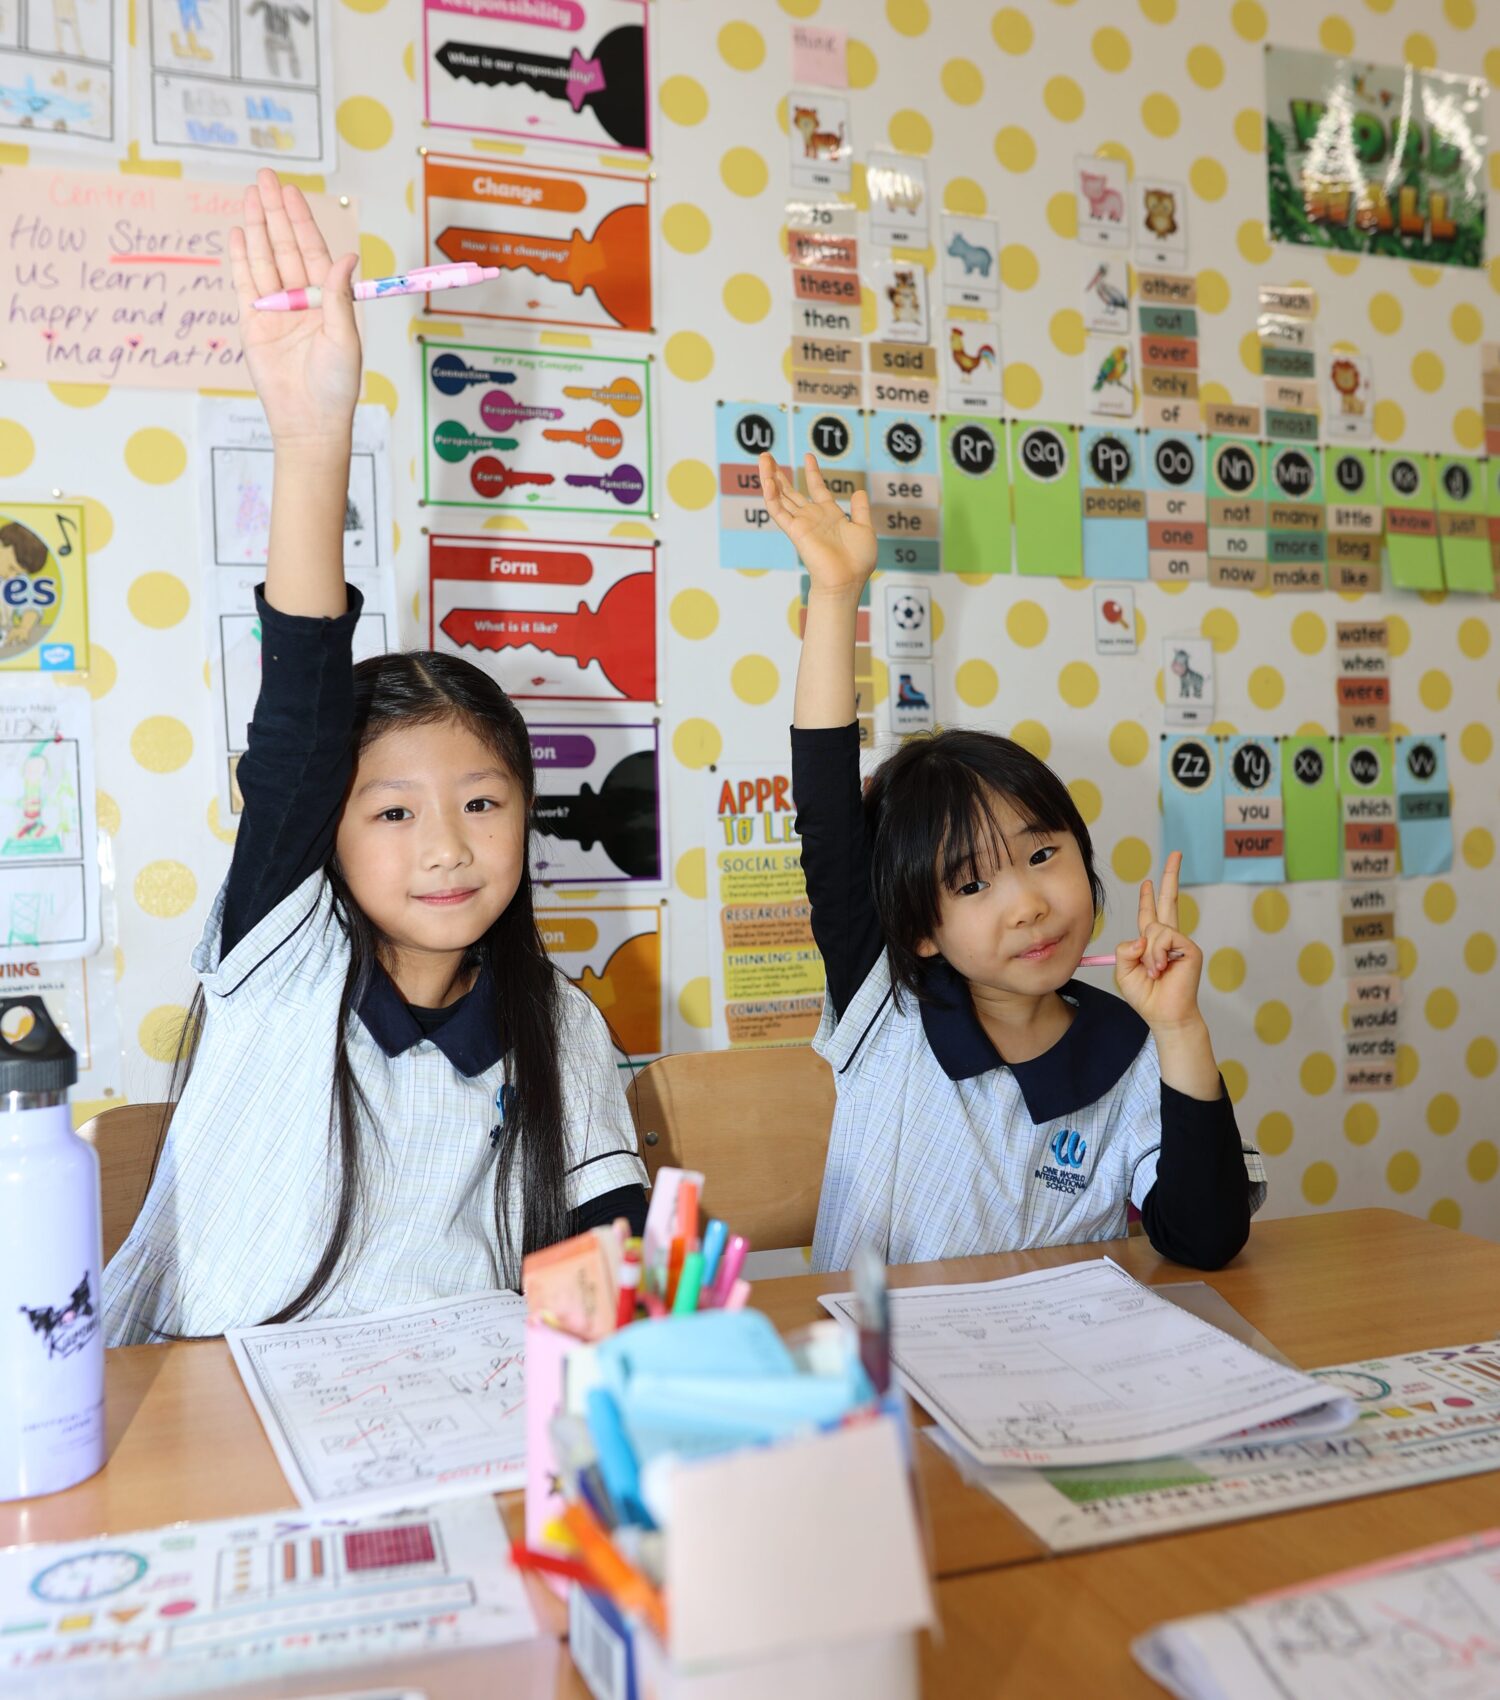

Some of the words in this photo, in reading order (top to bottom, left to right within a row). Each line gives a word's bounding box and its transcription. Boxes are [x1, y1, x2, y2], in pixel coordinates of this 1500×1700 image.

[440, 0, 572, 28] esponsibility
[447, 52, 480, 67] What
[50, 175, 156, 211] Central
[473, 177, 543, 205] Change
[9, 214, 86, 251] How
[109, 219, 224, 255] Stories
[514, 244, 569, 262] changing?
[15, 264, 60, 288] us
[801, 274, 855, 297] these
[1142, 279, 1190, 297] other
[8, 294, 96, 329] happy
[112, 302, 165, 325] and
[179, 309, 240, 340] grow
[803, 310, 850, 329] then
[1154, 313, 1183, 329] out
[803, 342, 851, 363] their
[883, 352, 923, 369] said
[1149, 346, 1189, 360] over
[797, 379, 858, 399] through
[876, 384, 929, 404] some
[1152, 376, 1187, 394] only
[1278, 386, 1303, 405] my
[1161, 406, 1180, 422] of
[1215, 411, 1249, 427] new
[1272, 416, 1313, 433] most
[435, 434, 493, 449] Perspective
[585, 433, 622, 447] Change
[739, 422, 772, 448] Uu
[818, 424, 843, 451] Tt
[891, 430, 917, 454] Ss
[959, 435, 992, 463] Rr
[1024, 438, 1063, 474] Qq
[1097, 444, 1127, 484] Pp
[1158, 446, 1192, 476] Oo
[1220, 455, 1250, 482] Nn
[476, 471, 503, 483] Form
[600, 477, 642, 491] Function
[887, 480, 923, 498] see
[1086, 495, 1141, 515] people
[1167, 499, 1186, 515] or
[1223, 506, 1250, 521] not
[745, 507, 770, 527] up
[887, 513, 922, 531] she
[1272, 508, 1319, 526] many
[1336, 509, 1372, 527] little
[1162, 530, 1193, 545] one
[1227, 537, 1248, 552] no
[895, 548, 917, 564] so
[1274, 539, 1319, 555] more
[1337, 540, 1371, 560] long
[490, 556, 538, 577] Form
[1168, 559, 1189, 574] on
[1220, 566, 1256, 582] now
[1273, 568, 1321, 586] make
[1340, 568, 1367, 586] like
[475, 620, 505, 633] What
[508, 621, 519, 633] is
[521, 621, 531, 634] it
[532, 622, 558, 635] like?
[1338, 627, 1385, 642] water
[1342, 656, 1384, 672] when
[1343, 686, 1384, 699] were
[1353, 713, 1376, 727] we
[1176, 752, 1206, 778] Zz
[1240, 750, 1265, 786] Yy
[1297, 756, 1319, 777] Xx
[718, 775, 797, 814] APPR
[537, 807, 569, 818] work?
[1238, 803, 1269, 822] you
[1347, 799, 1392, 818] which
[718, 816, 754, 846] TO
[1358, 827, 1383, 843] will
[1234, 836, 1274, 854] your
[723, 857, 777, 873] SOCIAL
[1351, 857, 1389, 874] what
[1351, 892, 1385, 908] with
[726, 907, 790, 922] RESEARCH
[1353, 922, 1384, 937] was
[727, 952, 792, 966] THINKING
[1355, 952, 1387, 969] who
[1357, 984, 1391, 1002] way
[1352, 1009, 1397, 1028] would
[1347, 1038, 1396, 1057] words
[1347, 1068, 1393, 1085] where
[1042, 1166, 1059, 1175] ONE
[1060, 1171, 1085, 1182] WORLD
[1046, 1181, 1076, 1195] SCHOOL
